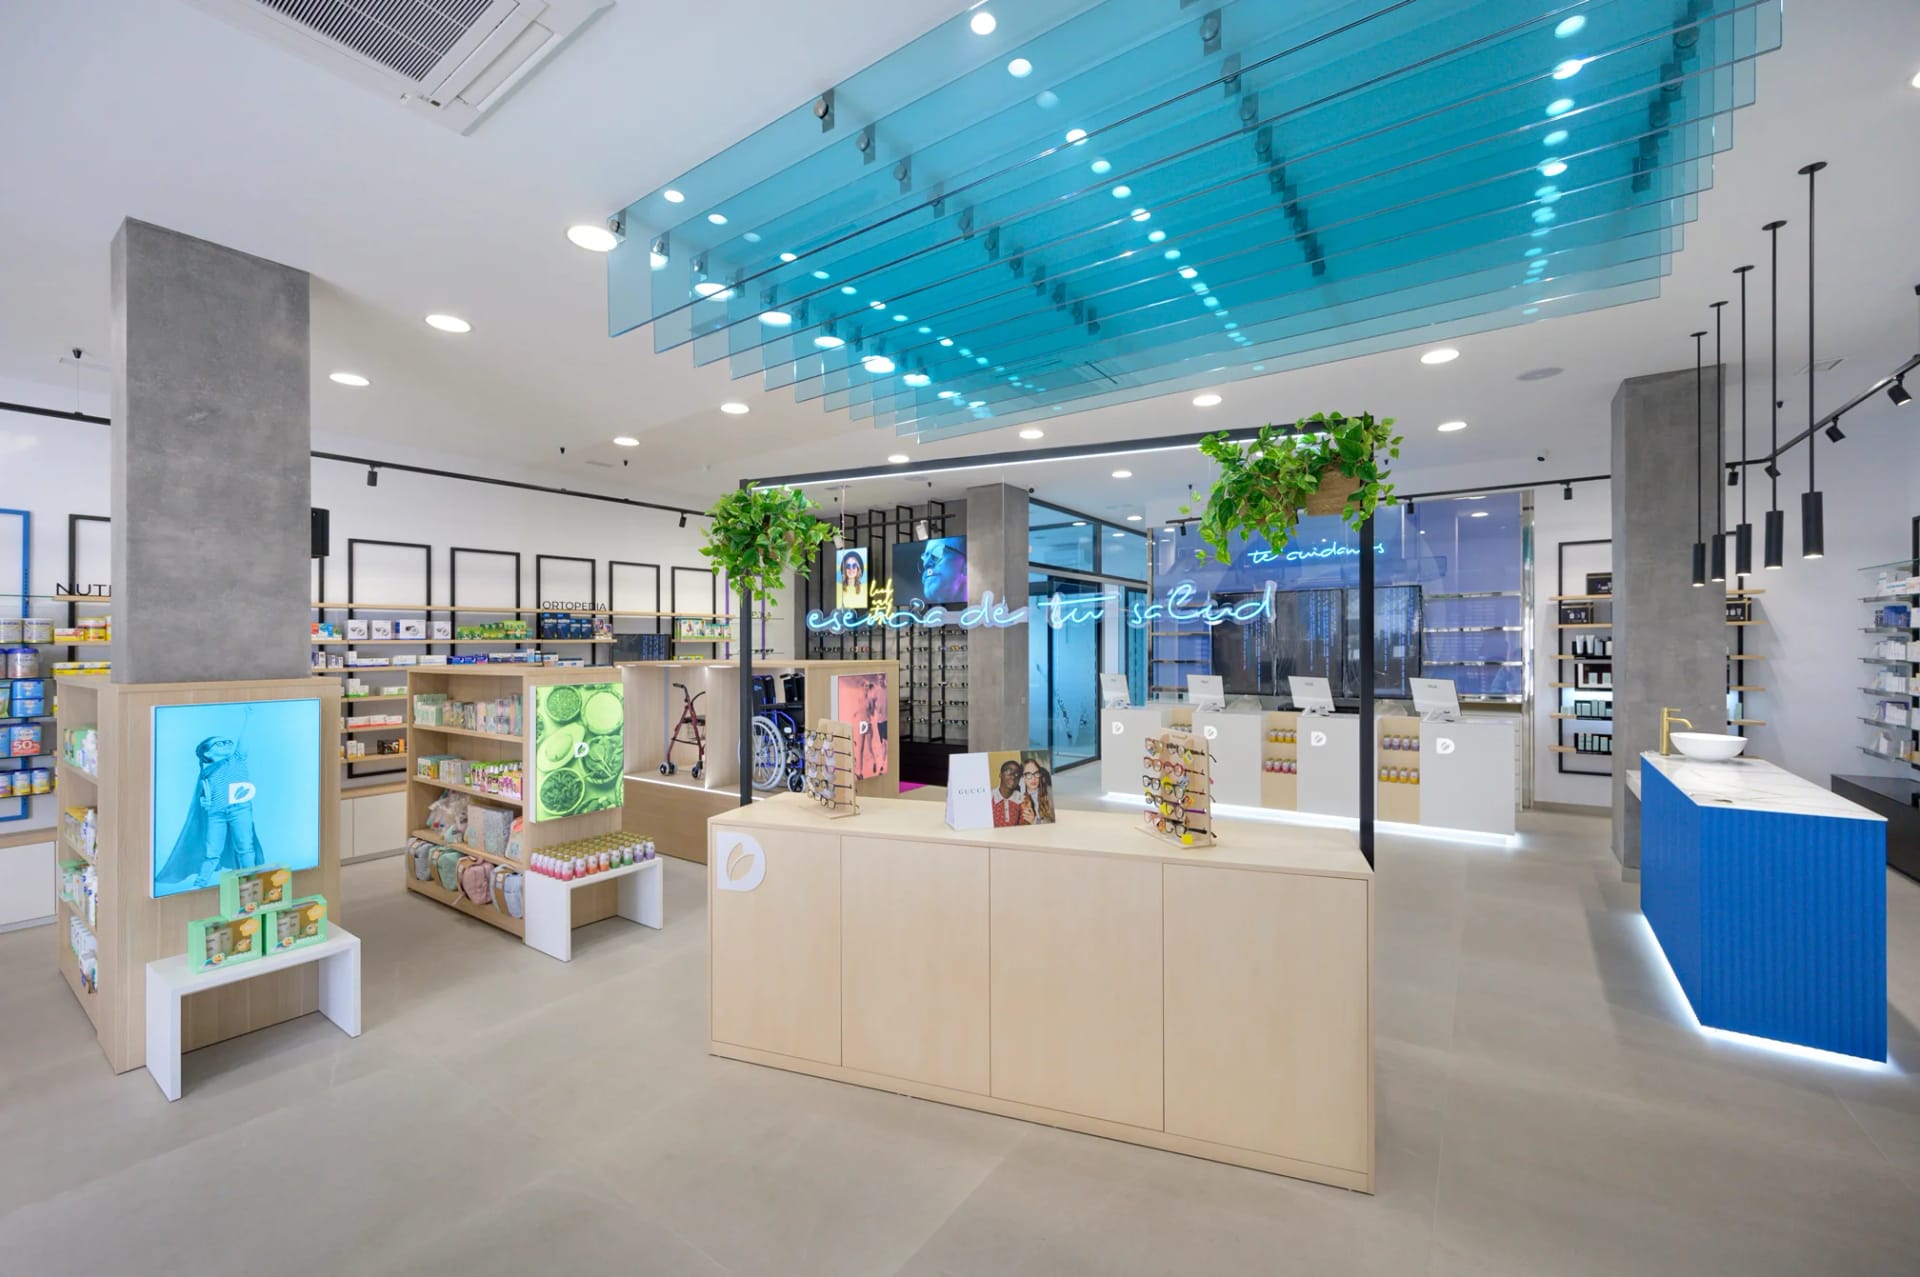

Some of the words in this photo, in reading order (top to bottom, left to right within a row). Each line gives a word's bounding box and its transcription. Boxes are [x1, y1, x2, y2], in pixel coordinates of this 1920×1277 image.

[1248, 549, 1279, 564] te
[542, 601, 607, 611] ORTOPEDIA
[807, 600, 943, 631] esencia
[959, 592, 1023, 626] de
[1038, 594, 1118, 626] tu
[1131, 583, 1272, 625] salud
[957, 786, 986, 796] GUCCI
